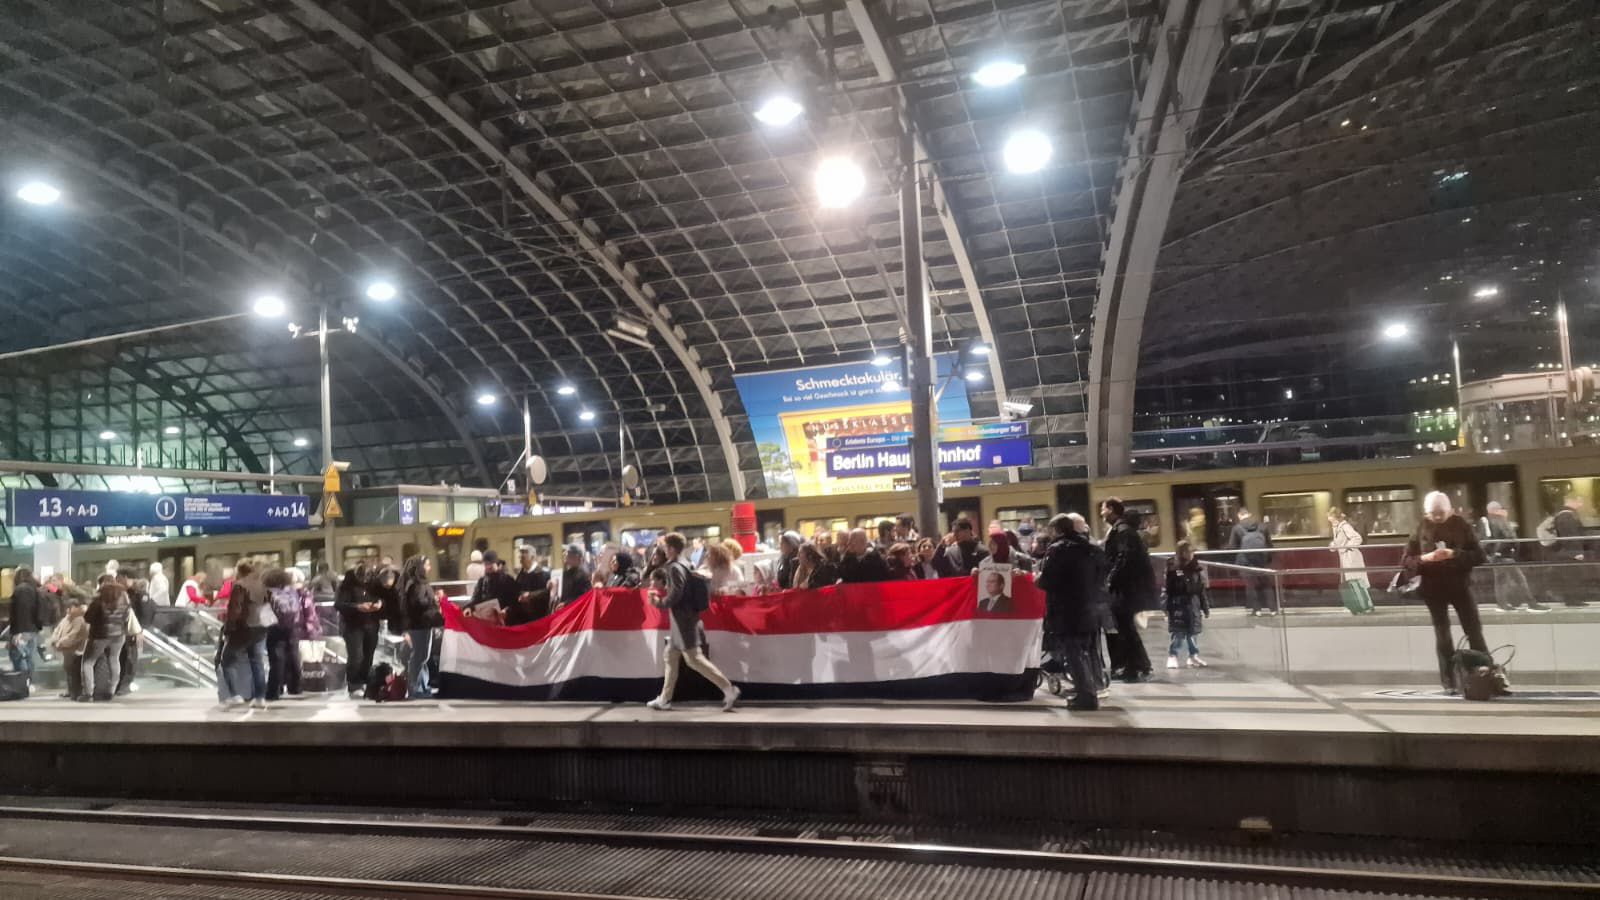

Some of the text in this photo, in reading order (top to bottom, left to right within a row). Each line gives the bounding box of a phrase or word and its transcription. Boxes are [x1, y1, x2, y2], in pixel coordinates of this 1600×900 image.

[833, 453, 874, 470] Berlin
[39, 497, 62, 517] 13
[291, 502, 306, 518] 14
